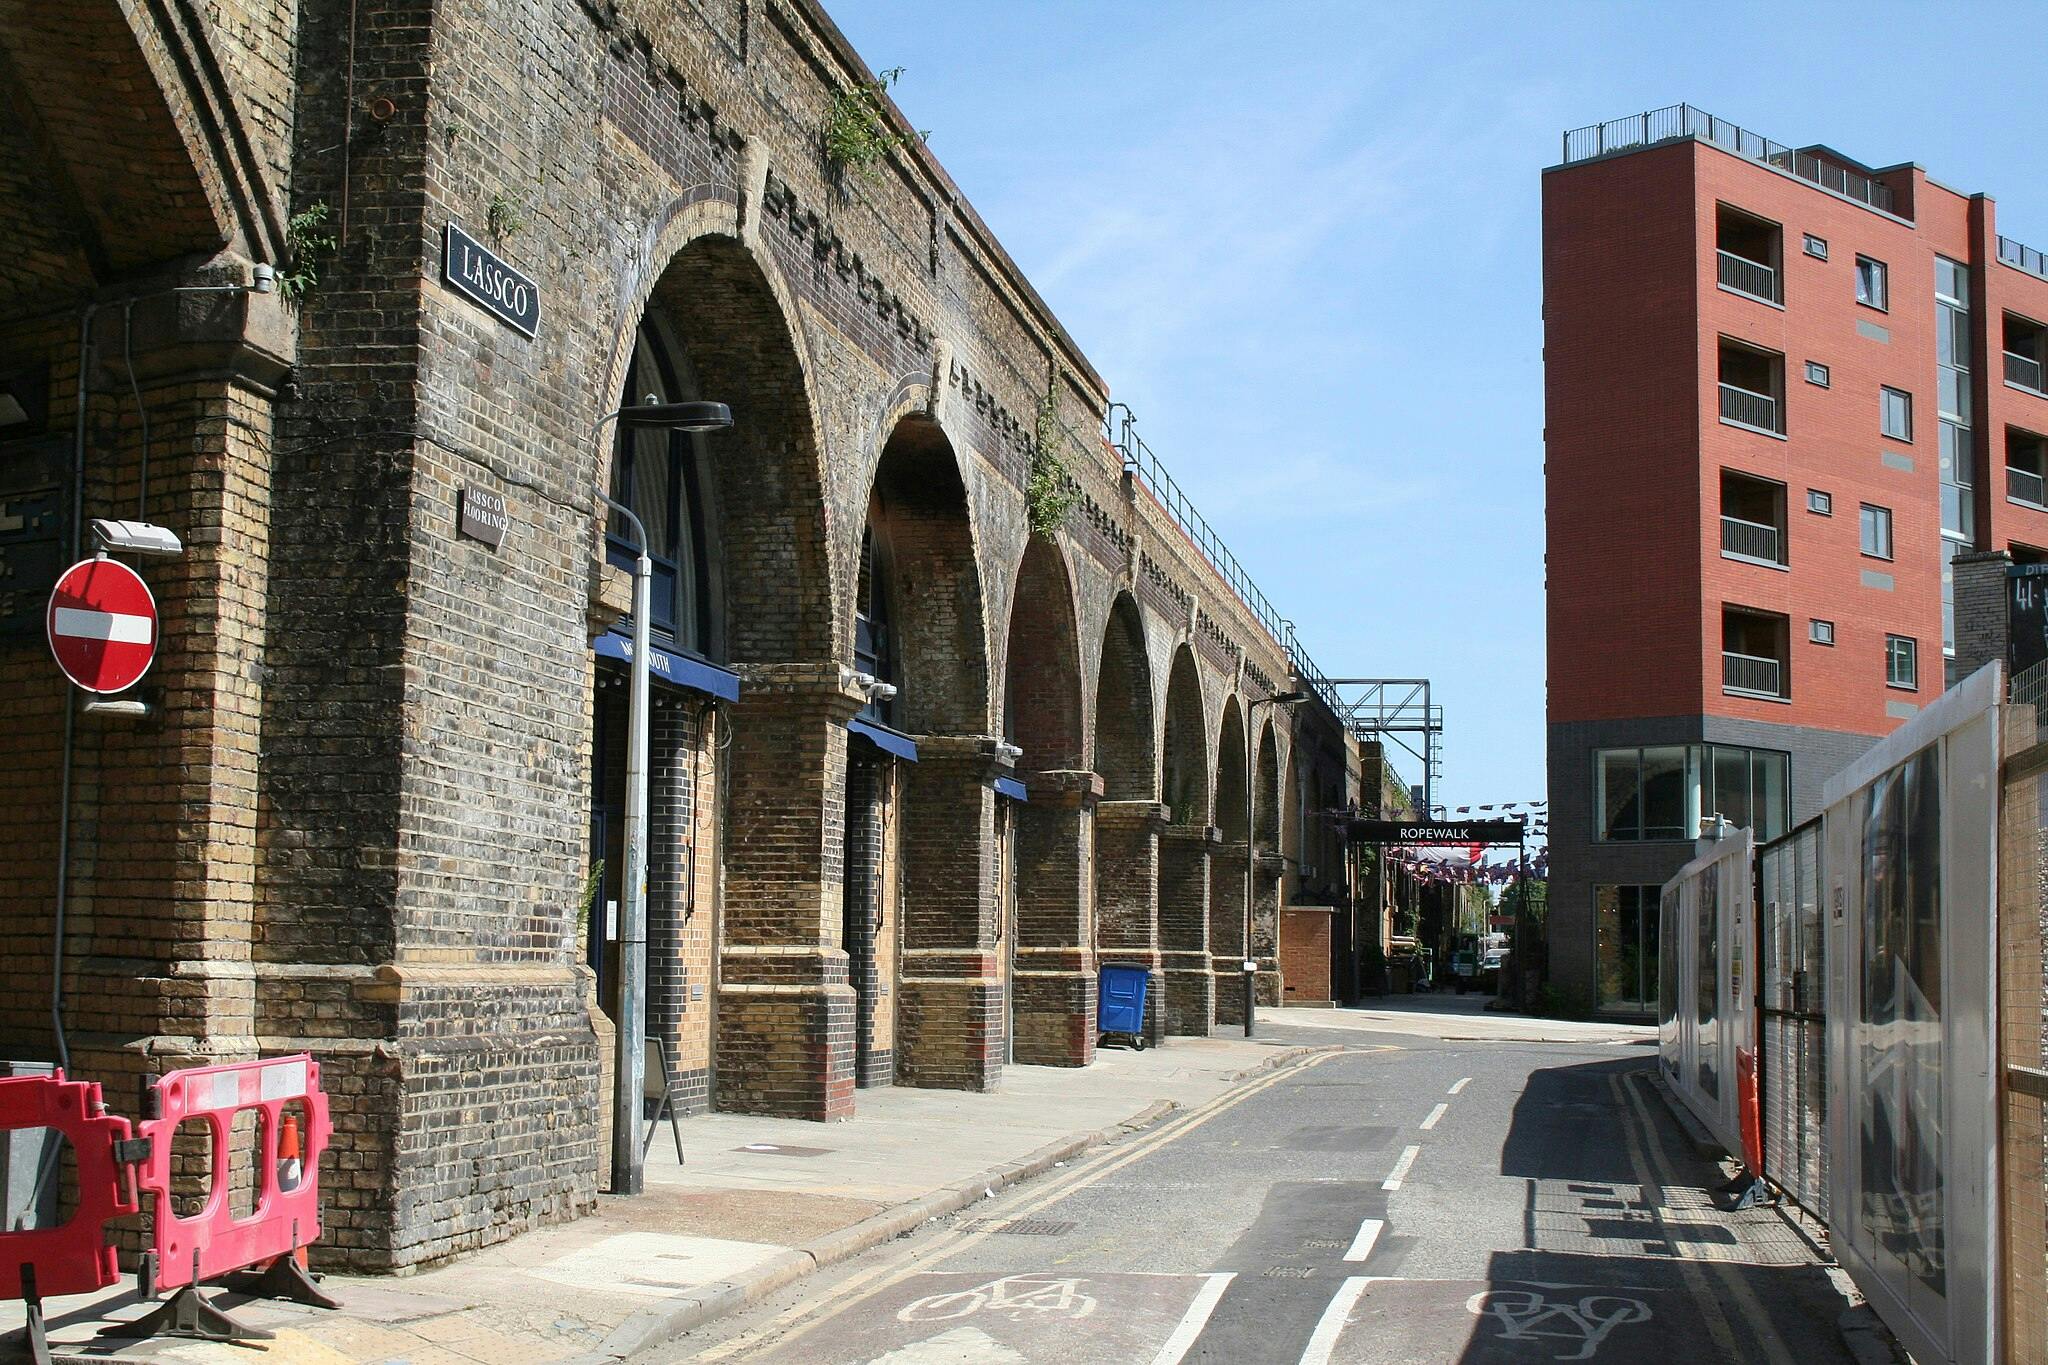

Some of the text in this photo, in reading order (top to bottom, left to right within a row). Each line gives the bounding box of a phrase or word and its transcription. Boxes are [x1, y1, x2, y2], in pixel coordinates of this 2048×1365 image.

[463, 245, 527, 316] LASSCO
[468, 486, 501, 511] LASSCO
[463, 501, 506, 530] FLOORING
[1400, 828, 1469, 839] ROPEWALK
